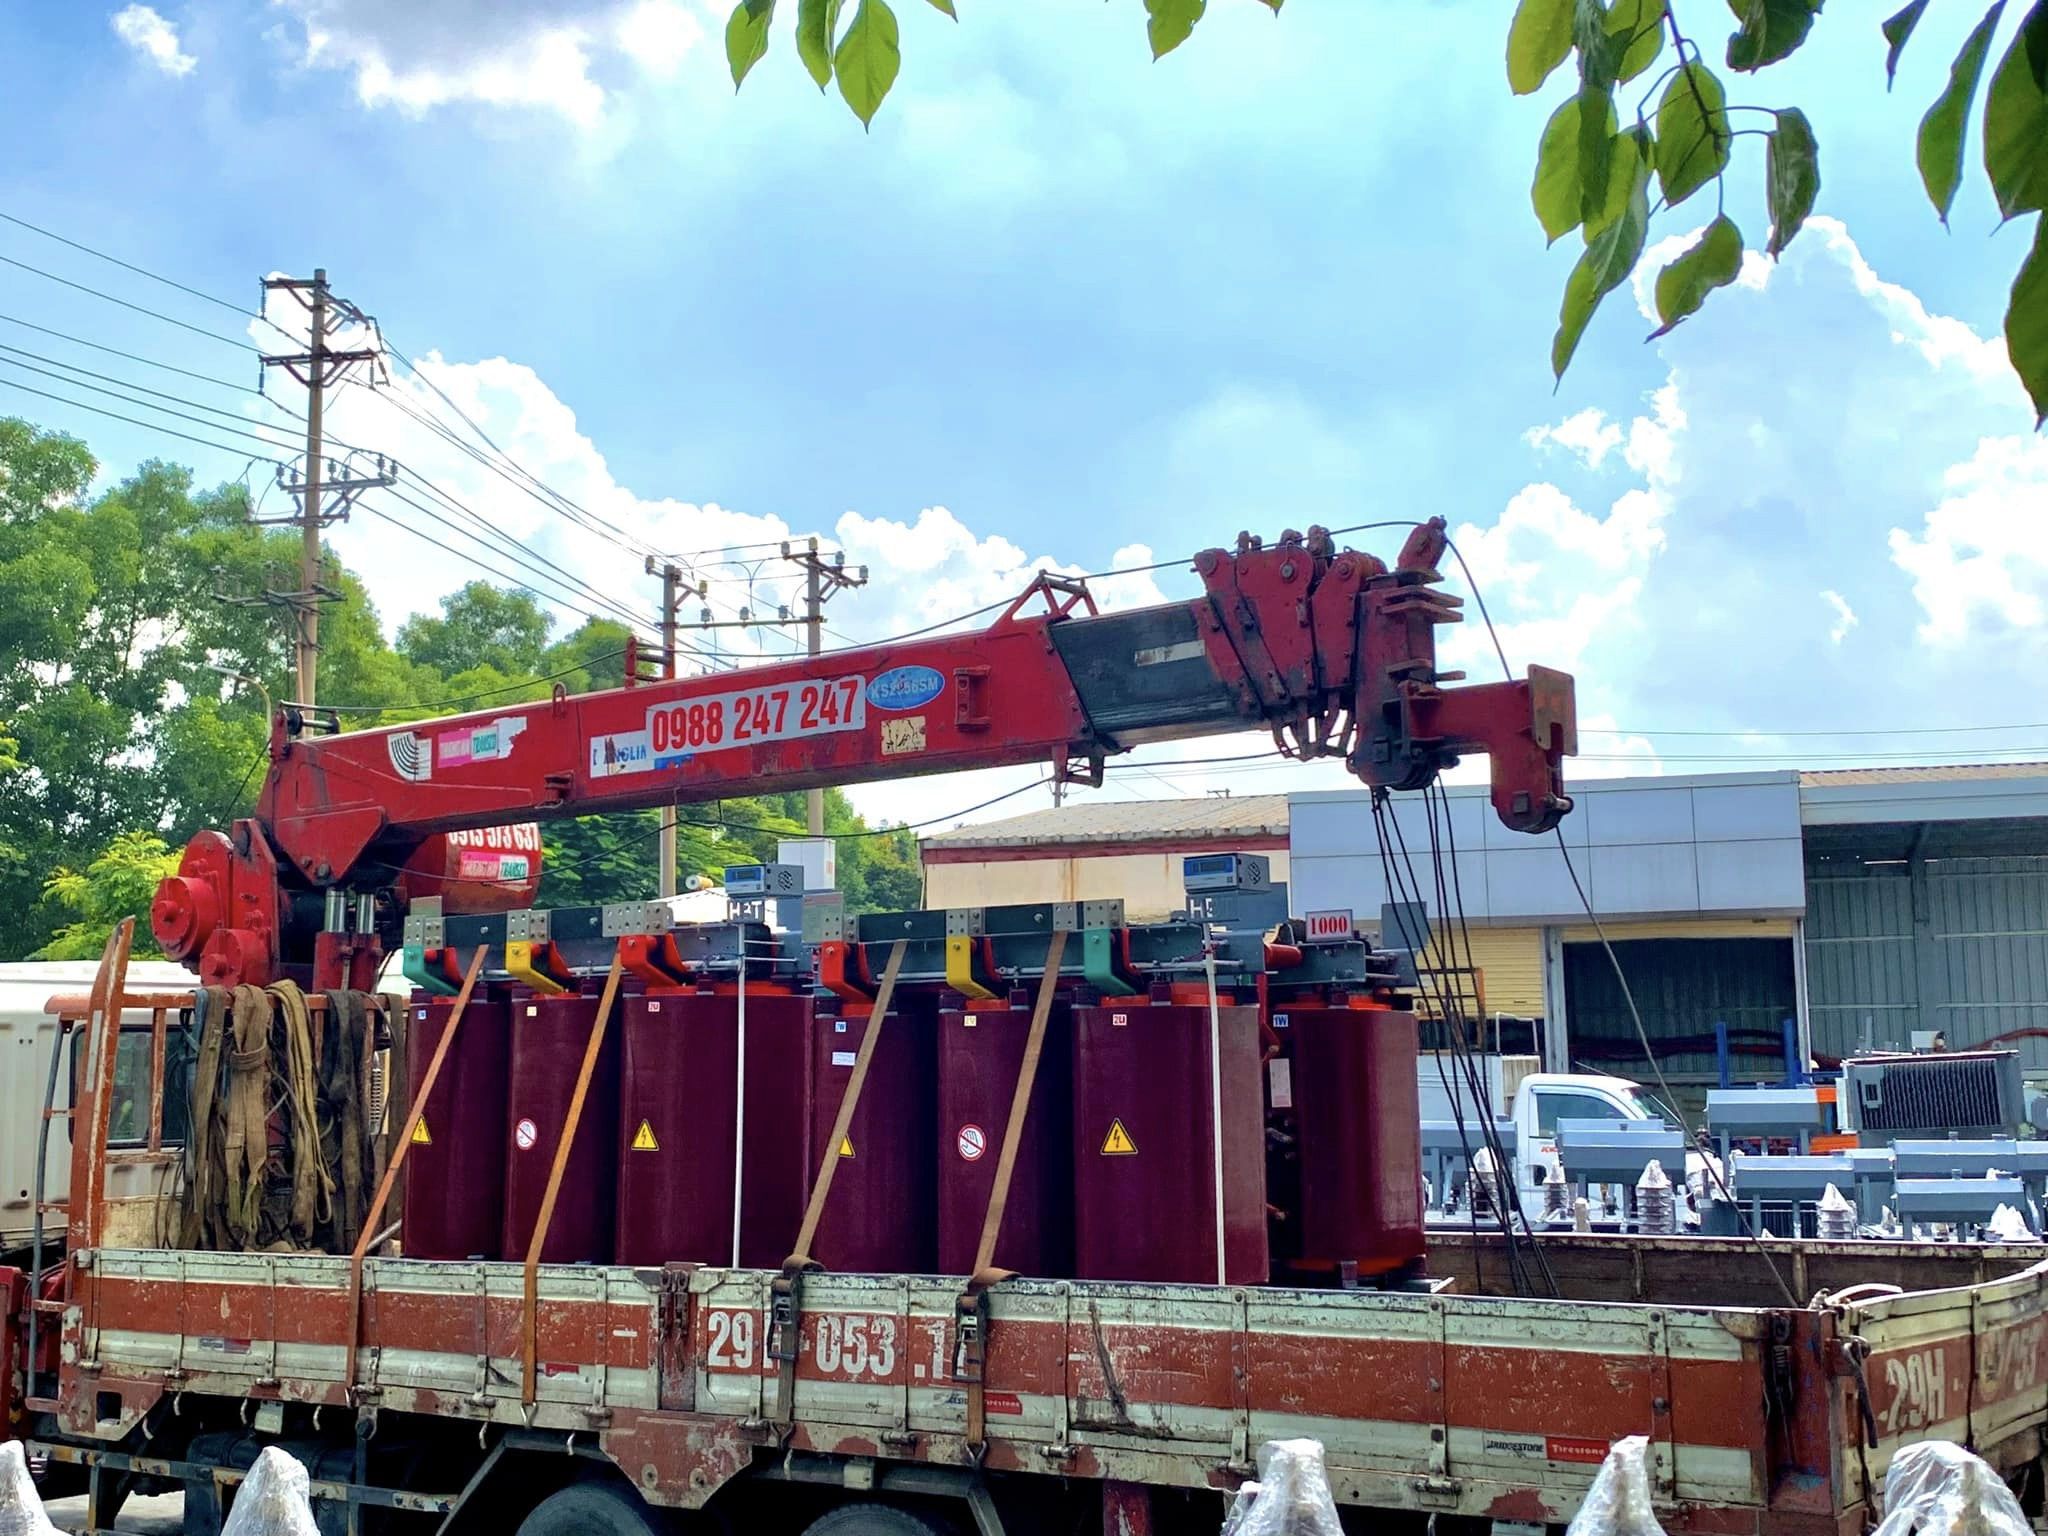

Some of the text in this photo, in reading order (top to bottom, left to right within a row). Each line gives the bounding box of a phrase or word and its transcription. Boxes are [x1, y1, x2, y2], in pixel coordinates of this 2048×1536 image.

[652, 680, 858, 753] 0988 247 247
[513, 822, 539, 851] 637
[1311, 916, 1348, 935] 1000
[1274, 1015, 1287, 1026] 1W
[816, 1314, 896, 1376] 053
[1878, 1348, 1945, 1432] 29H
[1487, 1440, 1606, 1456] BRIDGESTONE Firestone
